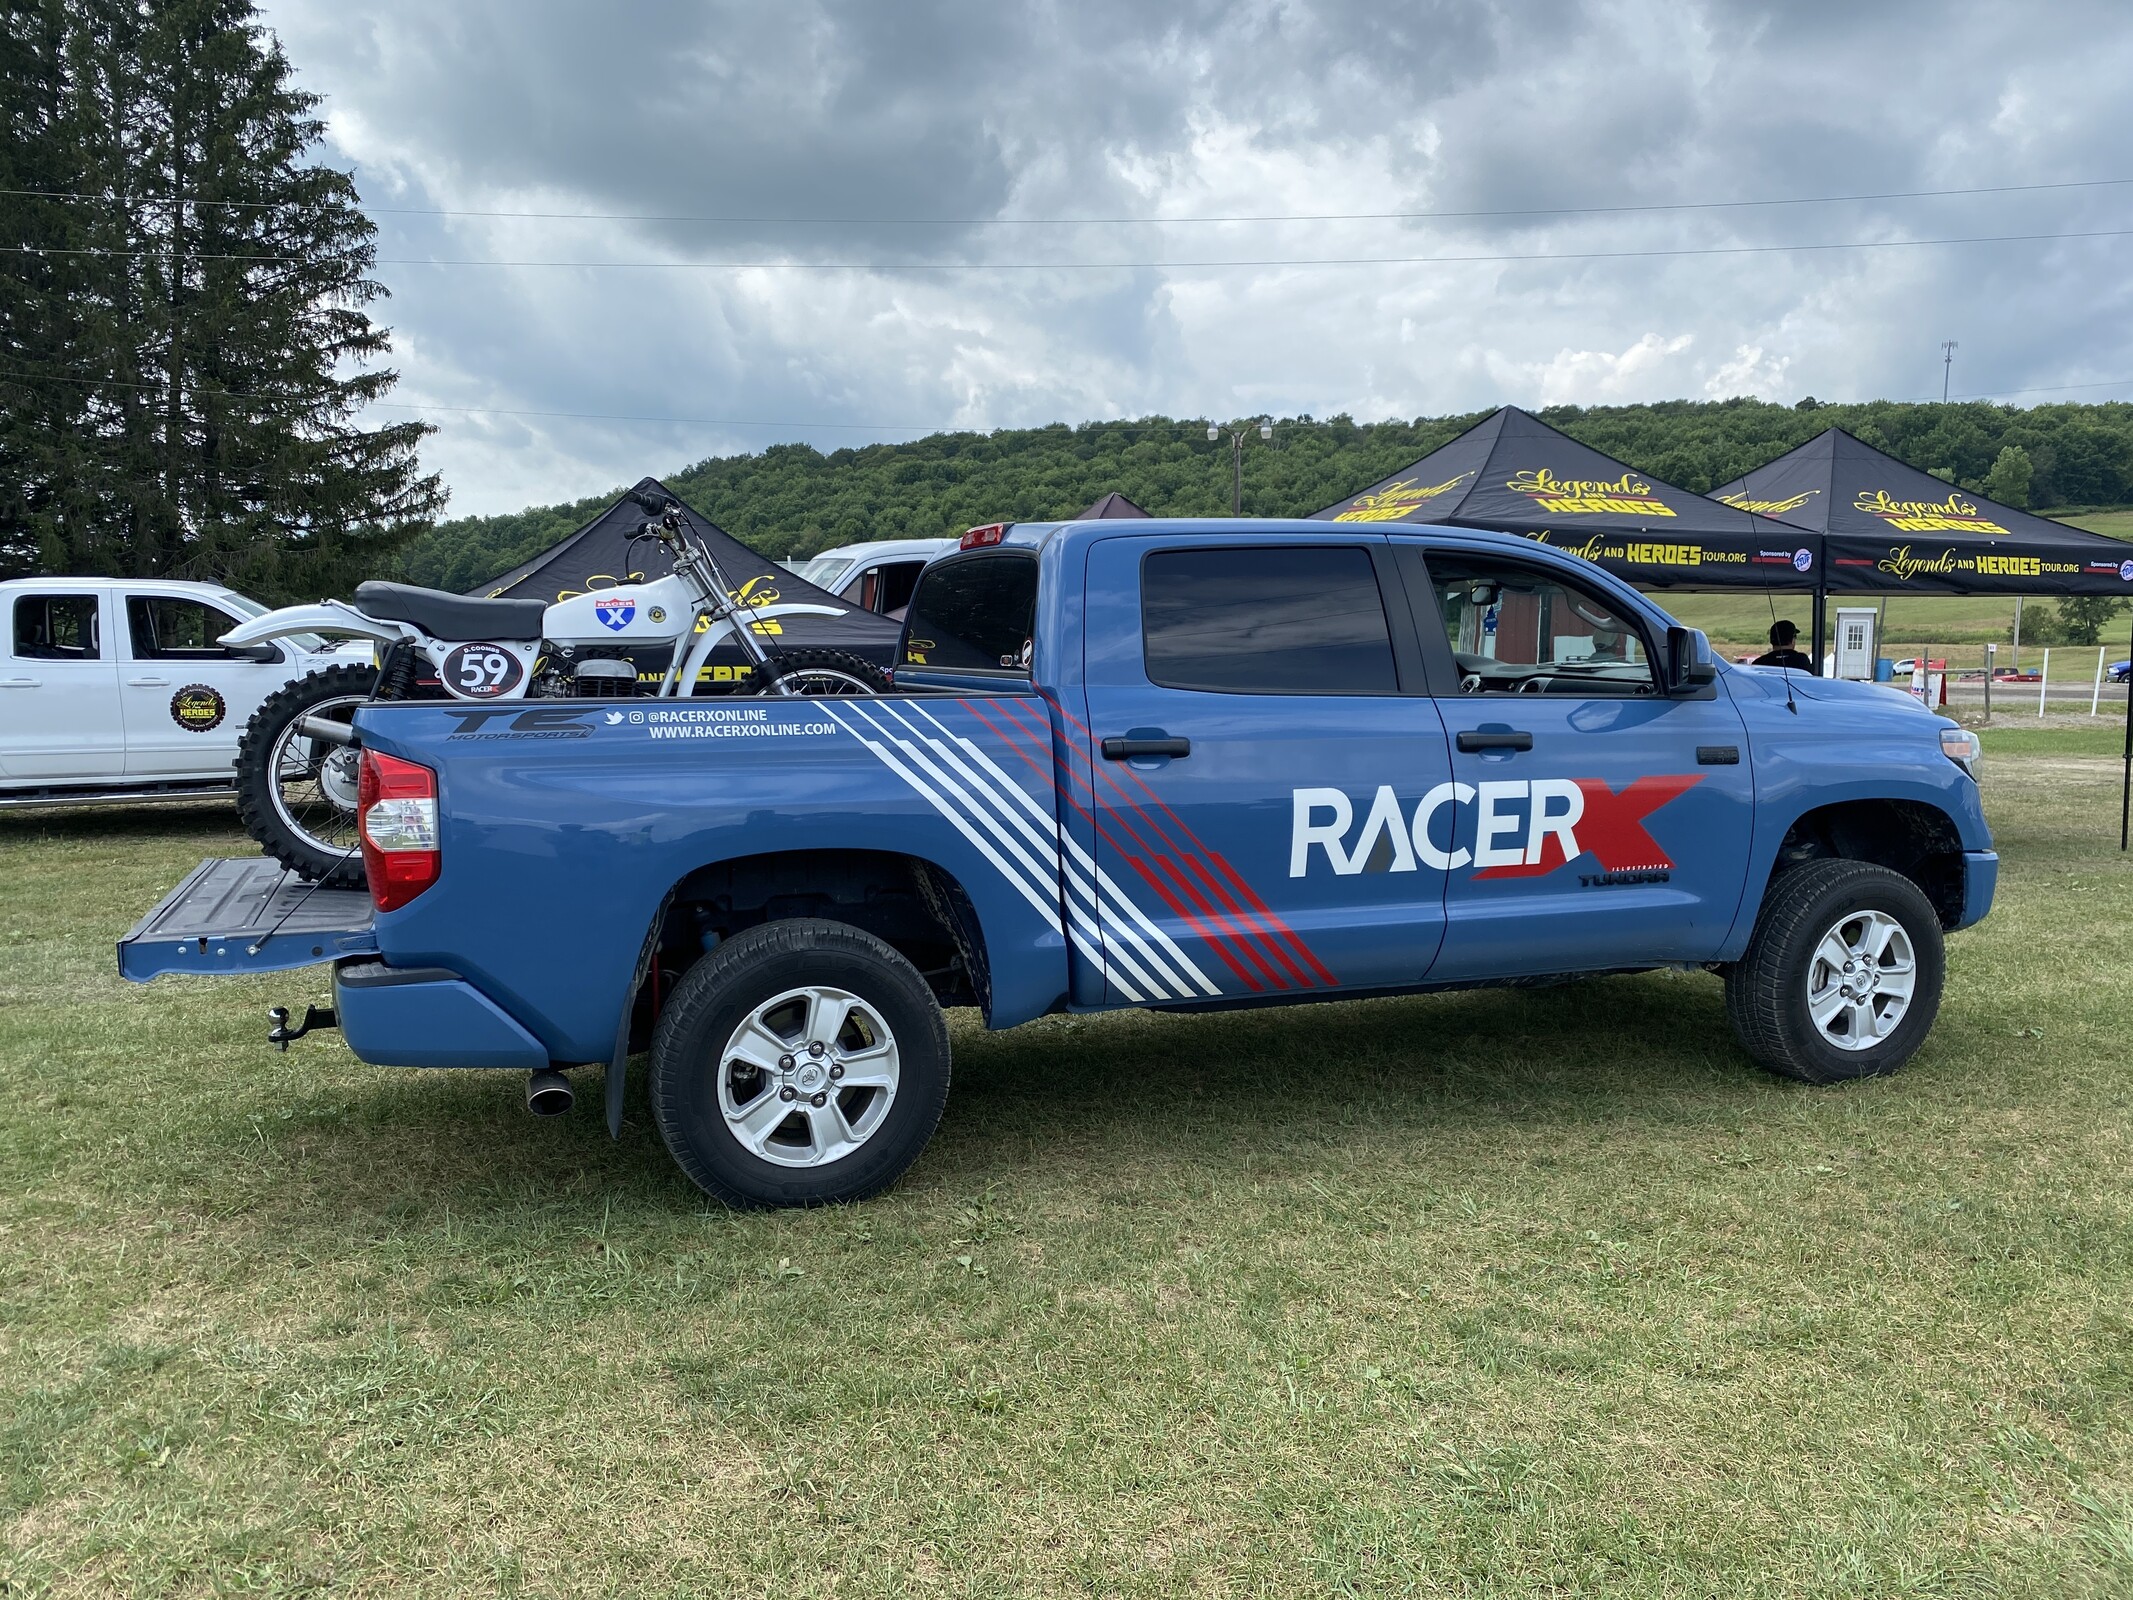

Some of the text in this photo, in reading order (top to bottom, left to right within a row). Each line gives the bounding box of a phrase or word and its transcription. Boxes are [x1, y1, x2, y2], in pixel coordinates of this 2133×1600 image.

[1506, 468, 1651, 498] Legends
[1535, 498, 1677, 516] HEROES
[1853, 490, 1977, 518] Legends
[1884, 518, 2012, 535] HEROES
[1604, 547, 1624, 559] AND
[1627, 543, 1701, 565] HEROES
[1702, 551, 1747, 563] TOUR.ORG
[1760, 549, 1792, 559] Sponsored by
[1877, 545, 2079, 580] Legends AND HEROES TOUR.ORG
[605, 608, 627, 625] X
[460, 653, 508, 687] 59
[180, 708, 215, 716] HEROES
[649, 709, 768, 723] @RACERXONLINE
[447, 731, 581, 741] MOTORSPORTS
[649, 723, 836, 739] WWW.RACERXONLINE.COM
[1612, 863, 1669, 872] ILLUSTRATED
[1577, 871, 1670, 887] TUNDRA
